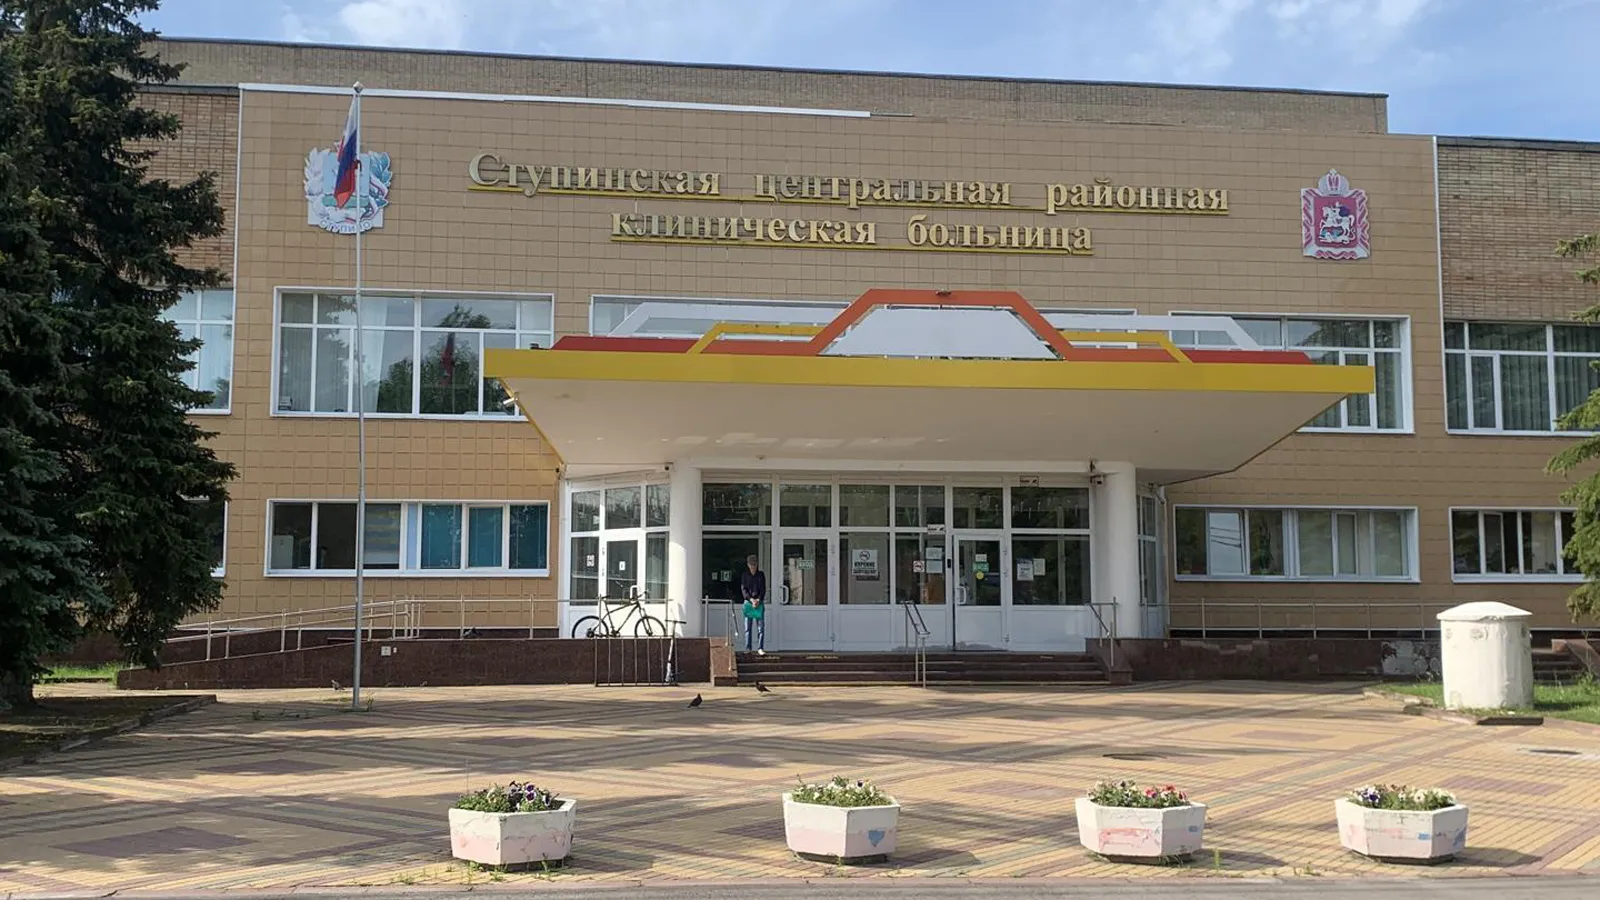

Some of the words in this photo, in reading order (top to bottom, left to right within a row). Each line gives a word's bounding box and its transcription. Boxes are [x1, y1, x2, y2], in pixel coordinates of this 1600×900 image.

[469, 153, 720, 198] Ступинская
[755, 174, 1011, 209] центральная
[1046, 176, 1229, 214] районная
[320, 219, 371, 233] СТУПИО
[611, 213, 876, 244] клиническая
[907, 214, 1092, 253] больница
